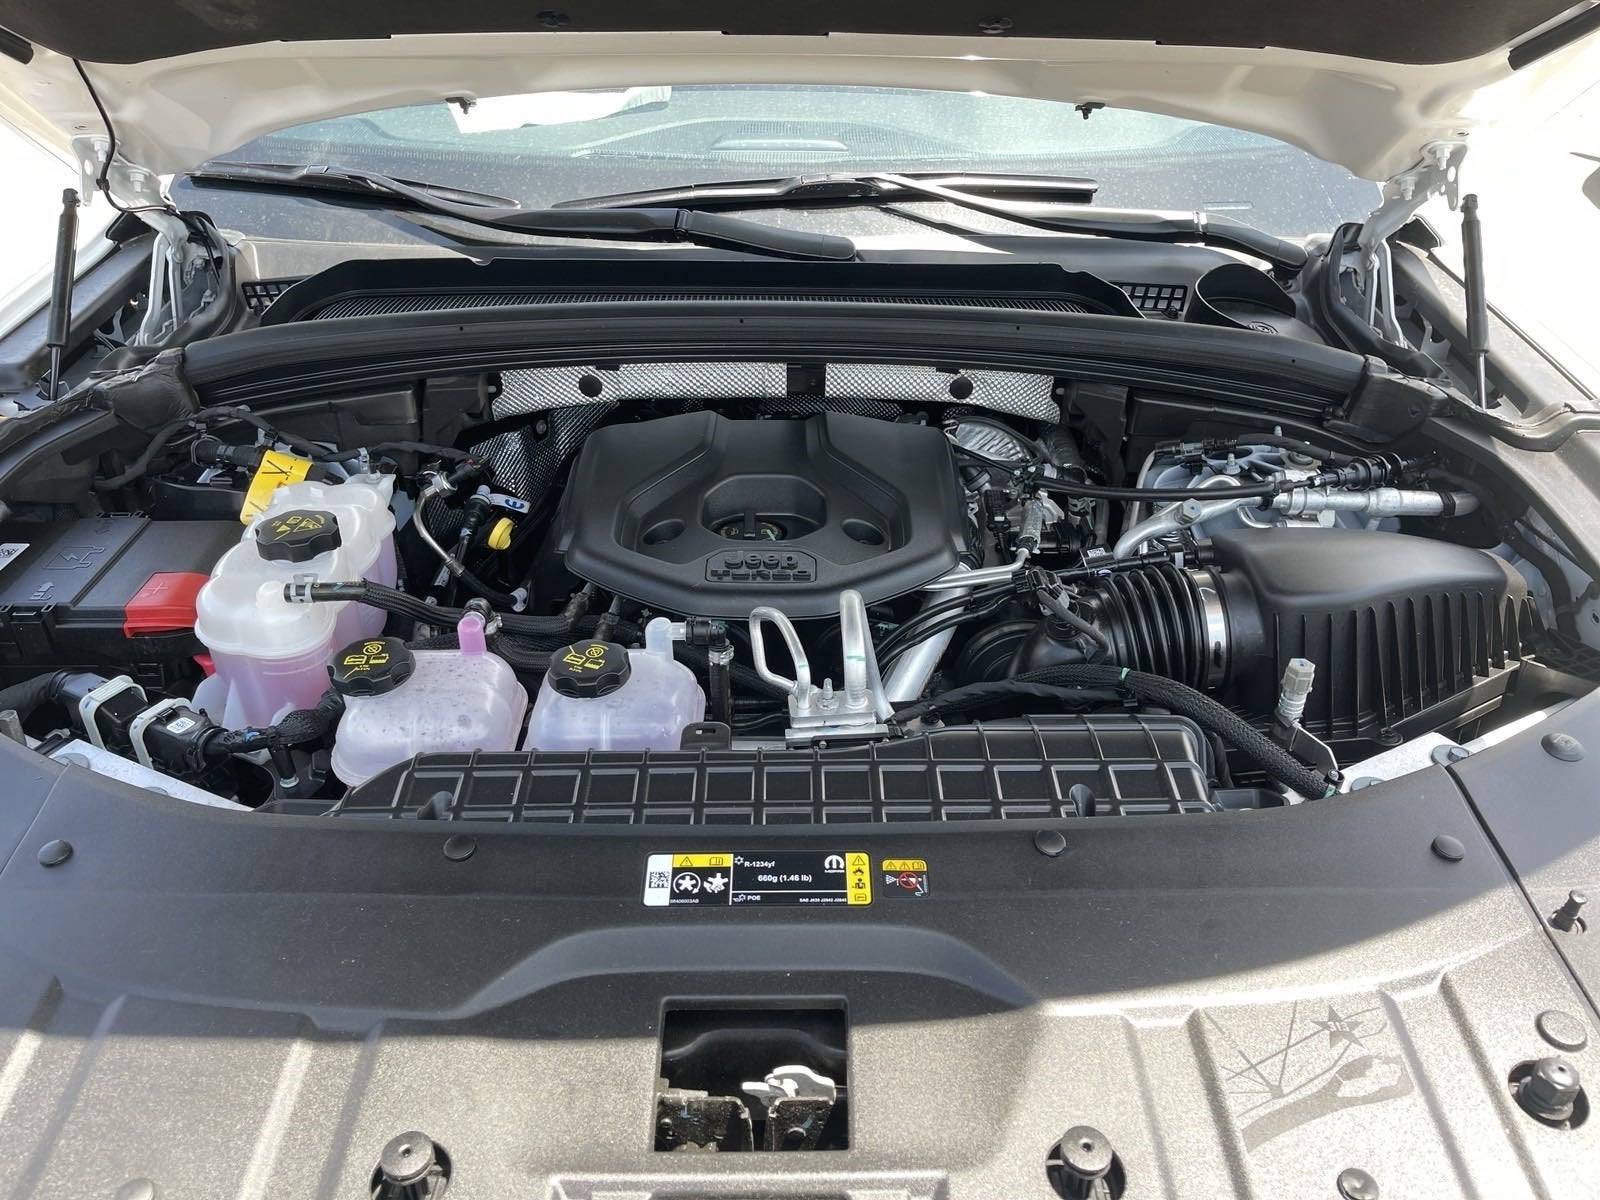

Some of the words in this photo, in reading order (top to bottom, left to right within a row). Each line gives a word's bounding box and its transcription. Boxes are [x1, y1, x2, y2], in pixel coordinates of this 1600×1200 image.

[724, 551, 799, 569] Jeep
[744, 860, 776, 869] R-1234yf
[801, 874, 813, 883] lb)
